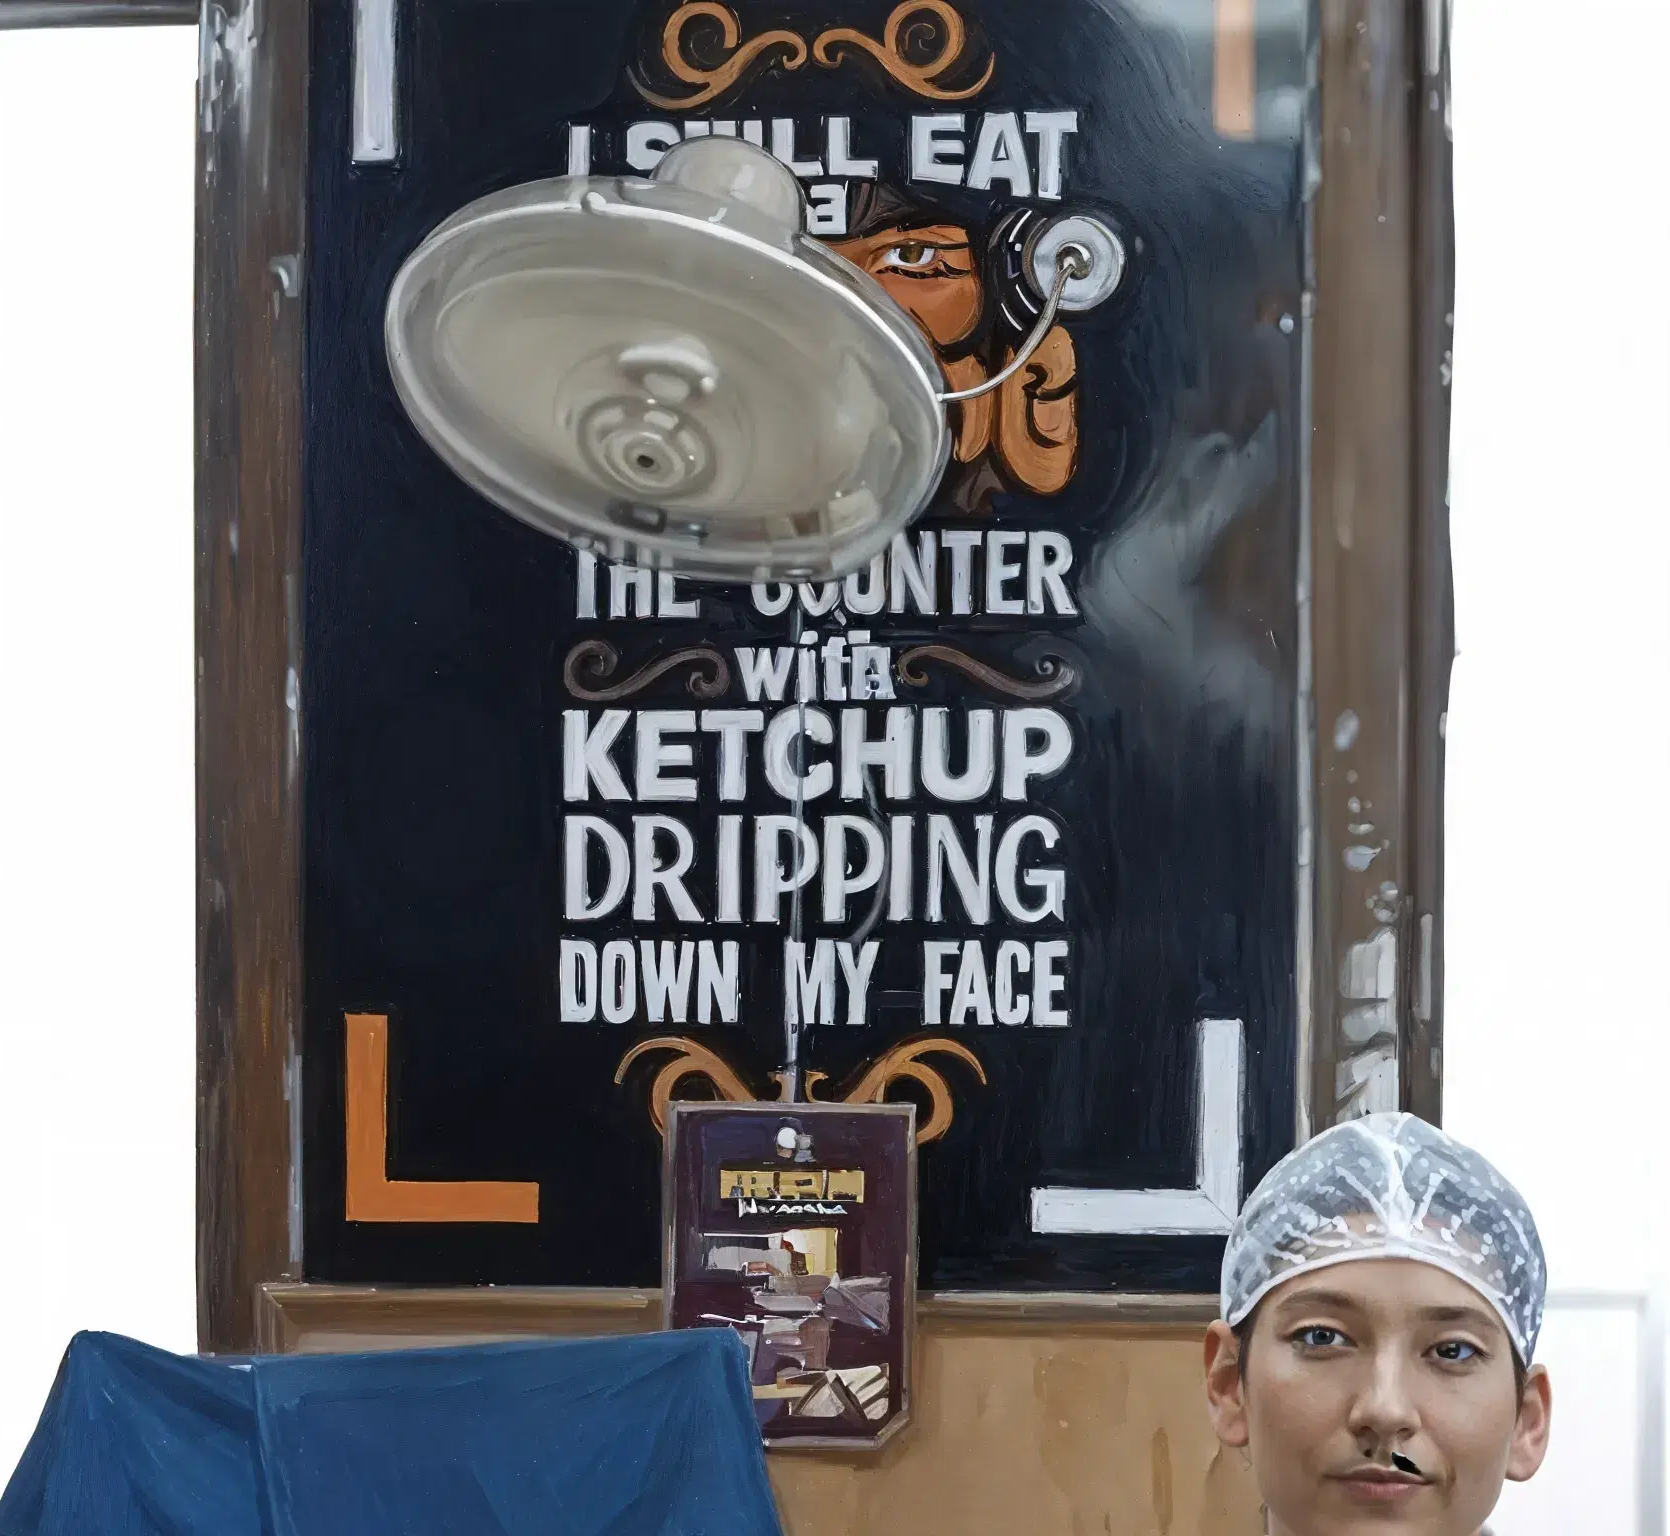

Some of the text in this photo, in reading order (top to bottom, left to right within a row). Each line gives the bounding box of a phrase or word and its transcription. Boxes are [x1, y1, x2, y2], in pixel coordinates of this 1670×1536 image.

[567, 110, 1078, 199] I SLL EAT
[561, 704, 1074, 803] KETCHUP
[562, 813, 1066, 926] DRIPPING
[559, 937, 1071, 1027] DOWN MY FACE
